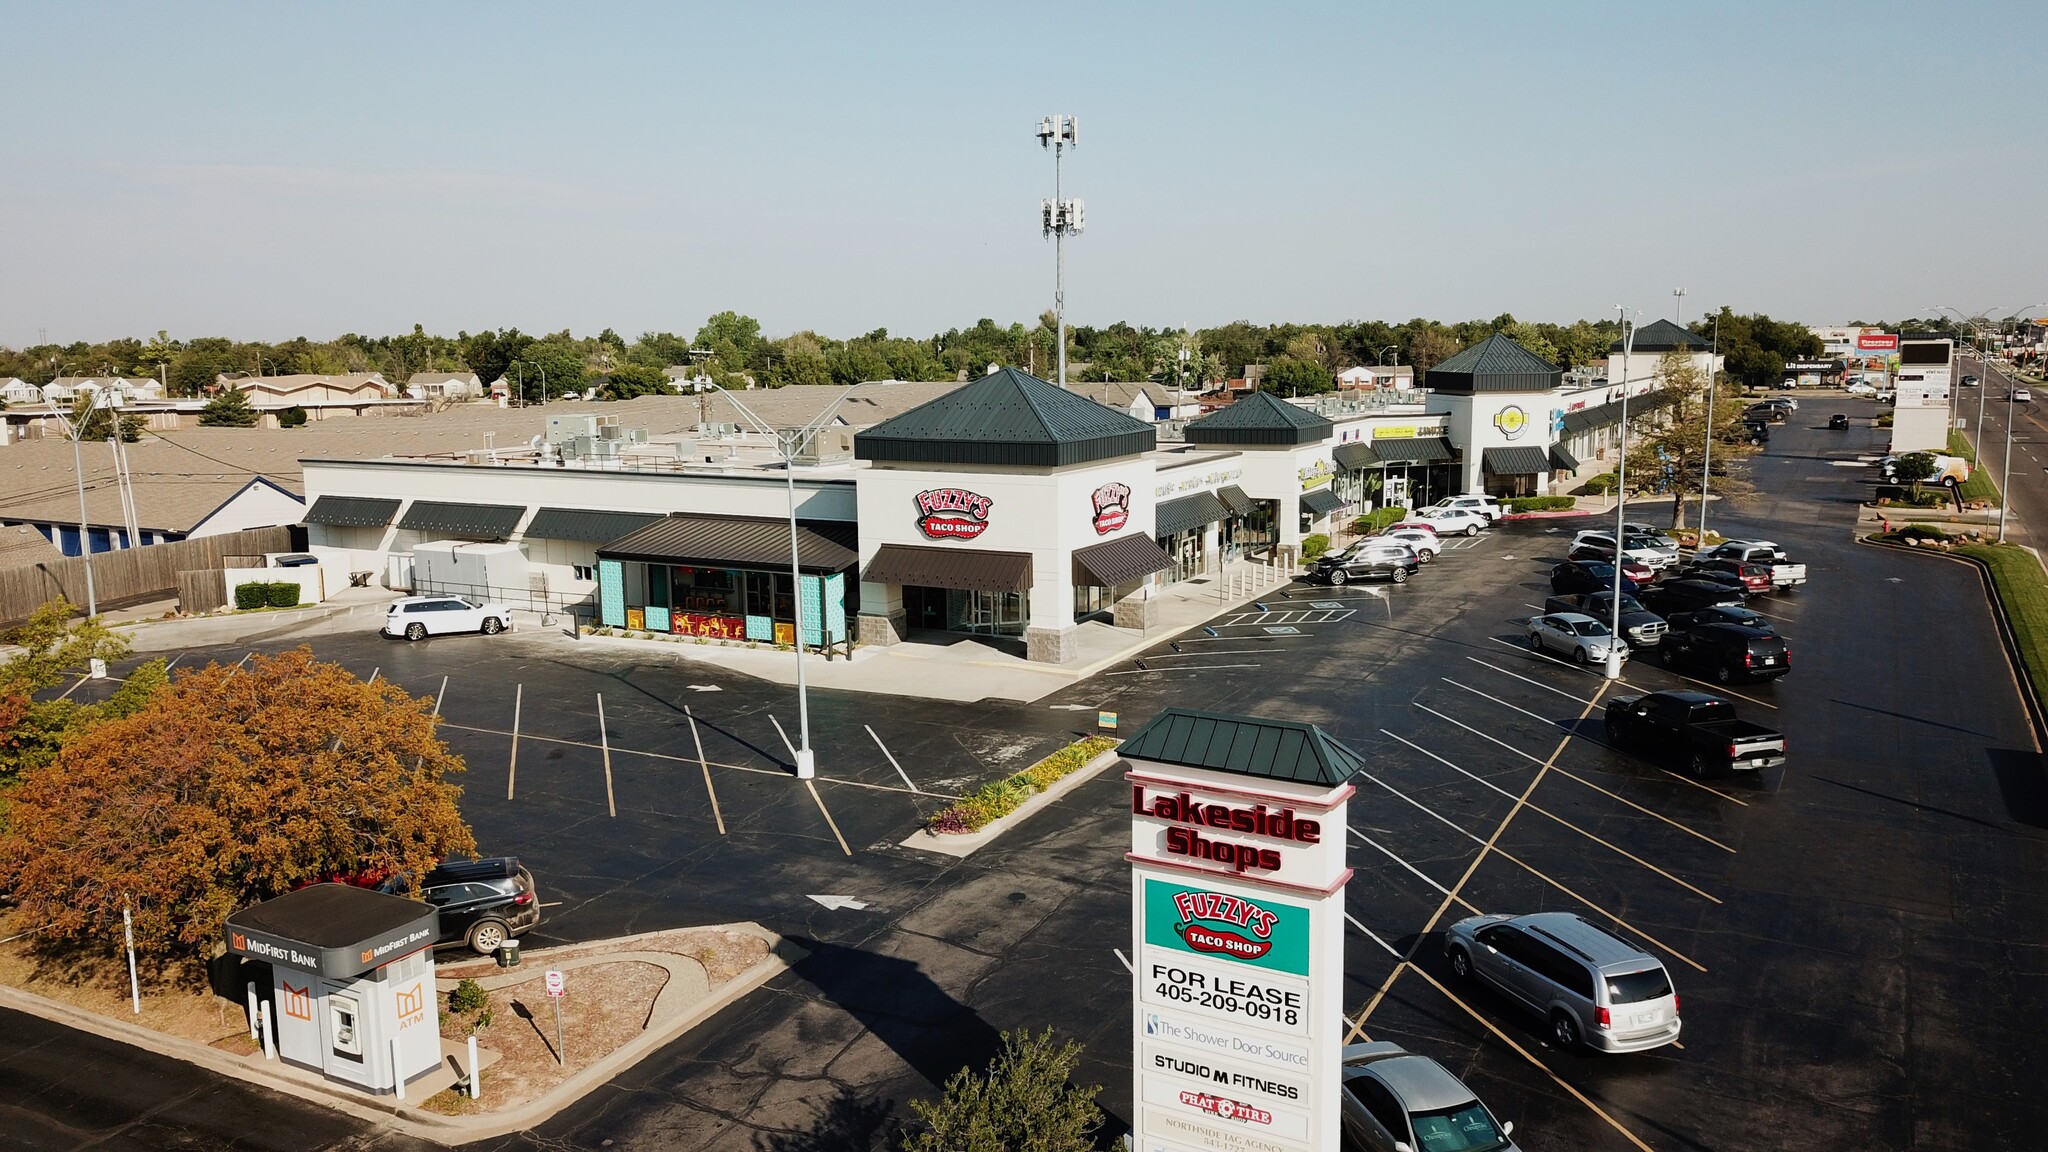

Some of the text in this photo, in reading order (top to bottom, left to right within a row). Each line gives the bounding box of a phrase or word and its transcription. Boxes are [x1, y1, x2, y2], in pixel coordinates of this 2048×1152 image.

[918, 489, 992, 518] FUZZY'S
[929, 522, 981, 533] TACO SHOP
[1133, 784, 1320, 844] Lakeside
[1166, 825, 1281, 873] Shops
[1173, 891, 1278, 938] FUZZY'S
[1190, 932, 1262, 954] TACO SHOP
[1152, 964, 1301, 1009] FOR LEASE
[1155, 982, 1298, 1026] 405-209-0918
[399, 1012, 425, 1031] ATM
[1160, 1020, 1308, 1066] The Shower Door Source
[1155, 1055, 1299, 1099] STUDIO M FITNESS
[1181, 1092, 1270, 1124] PHAT TIRE
[1165, 1118, 1285, 1152] NORTHSIDE TAG AGENCY
